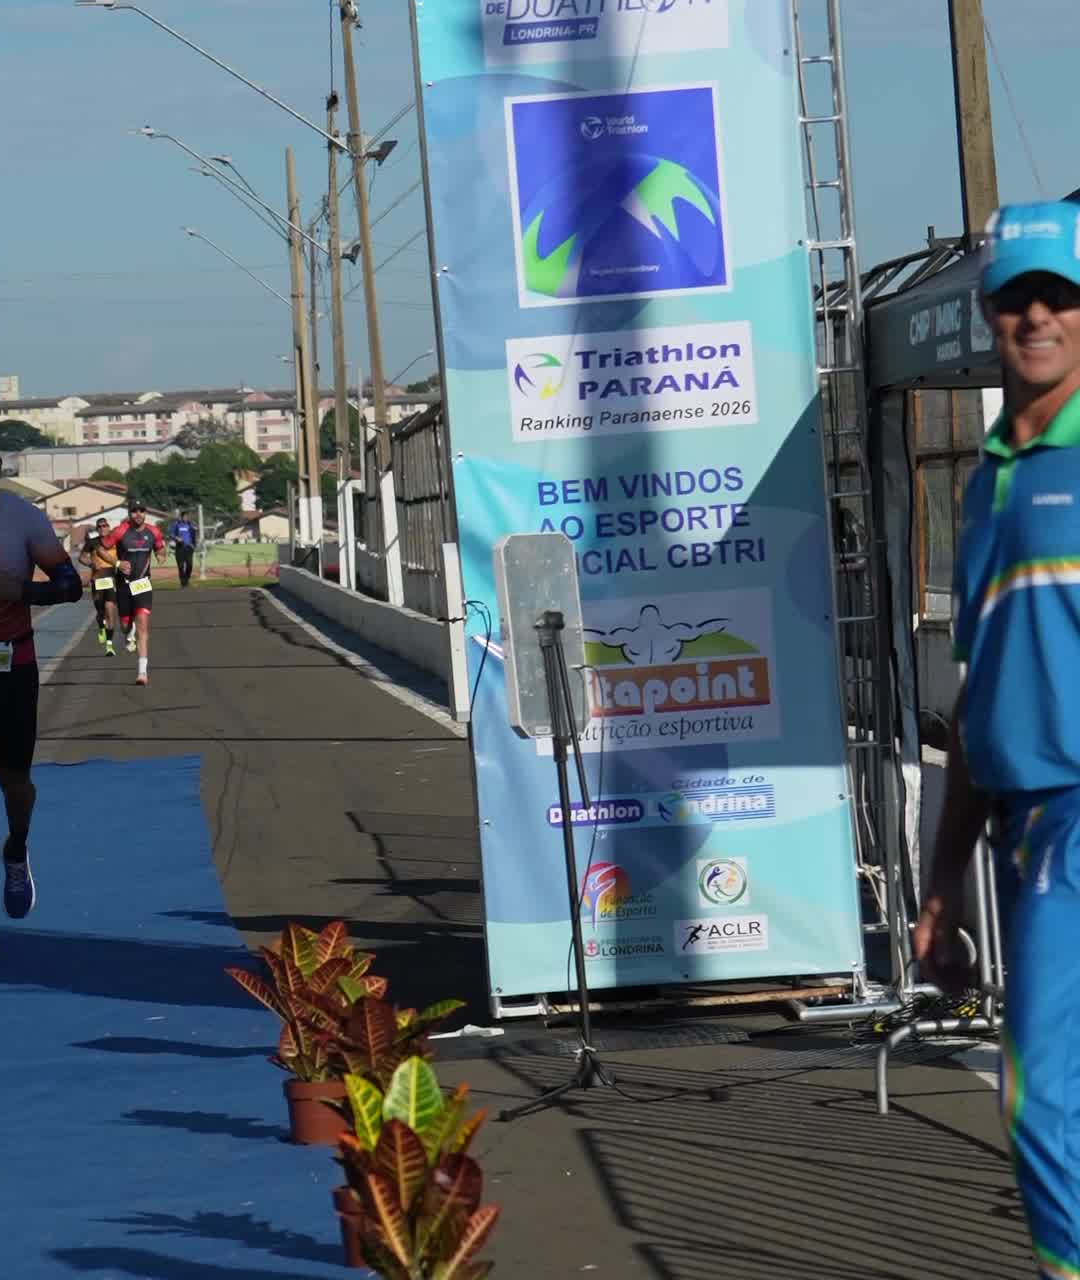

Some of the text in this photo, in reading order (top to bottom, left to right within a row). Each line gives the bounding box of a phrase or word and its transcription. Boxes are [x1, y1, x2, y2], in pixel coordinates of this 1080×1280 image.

[486, 2, 505, 15] DE
[578, 24, 595, 36] PR
[576, 342, 742, 370] Triathlon
[579, 366, 740, 401] PARANÁ
[520, 400, 752, 432] Ranking Paranaense 2026
[538, 466, 744, 506] BEM VINDOS
[596, 503, 751, 538] ESPORTE
[667, 537, 766, 569] CBTRI
[659, 711, 755, 741] esportiva
[672, 774, 765, 790] Cidade de
[708, 921, 762, 937] ACLR
